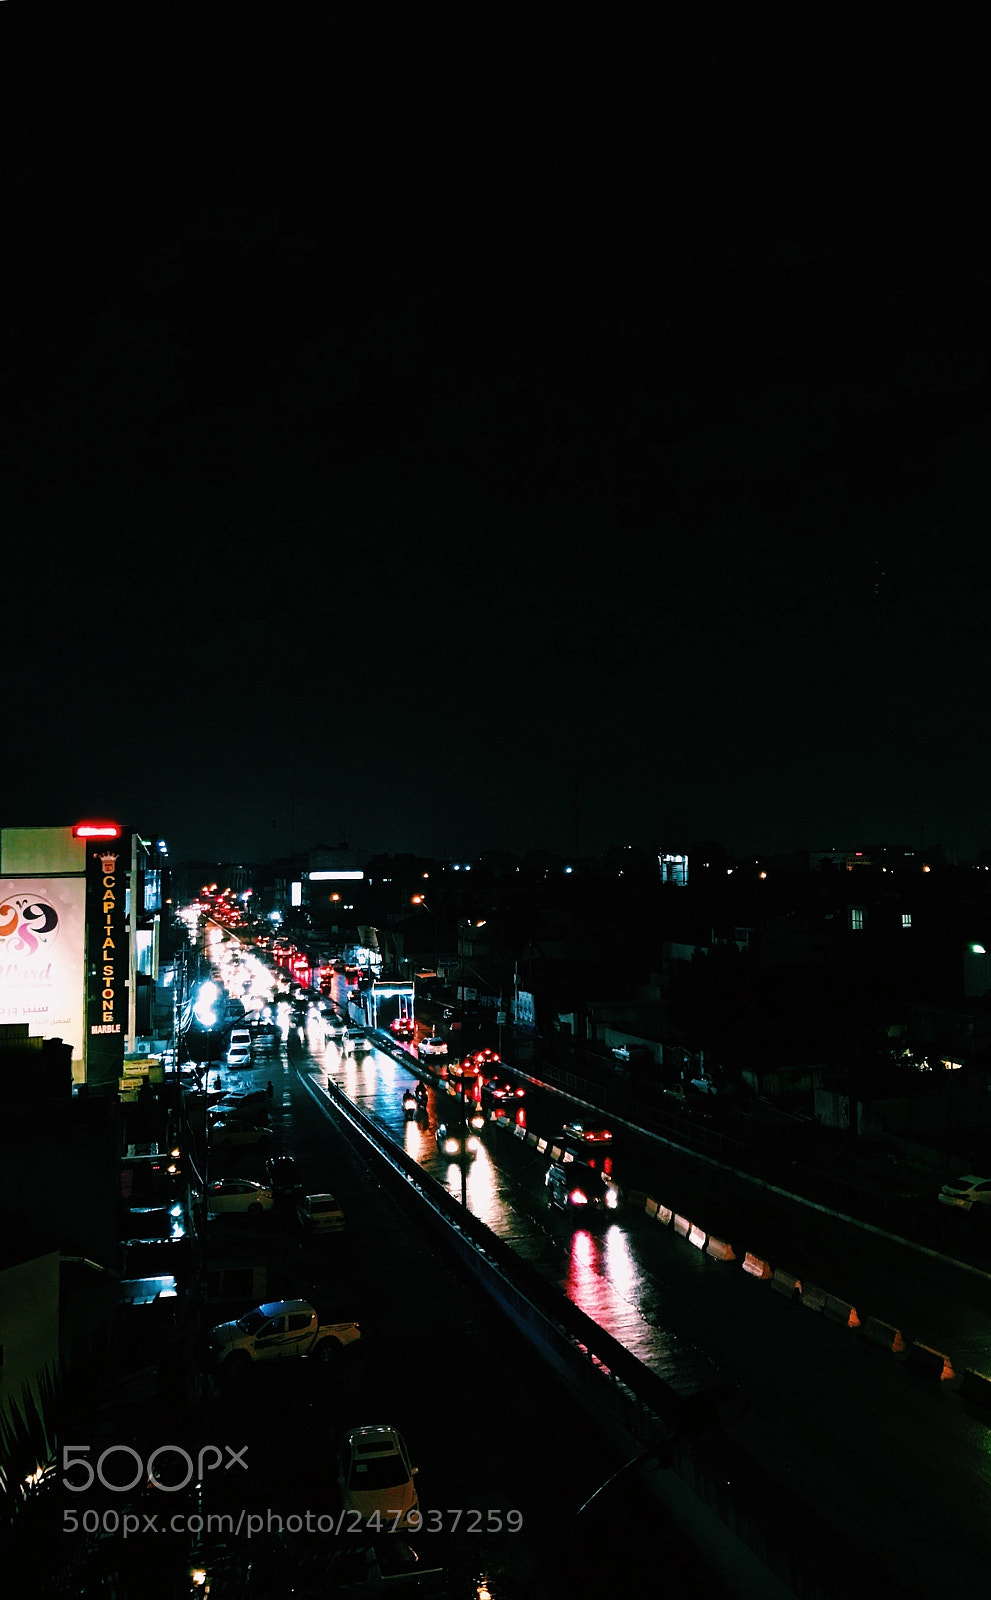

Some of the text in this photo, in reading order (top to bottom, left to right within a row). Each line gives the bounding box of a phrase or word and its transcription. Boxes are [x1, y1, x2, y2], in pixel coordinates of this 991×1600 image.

[102, 875, 116, 1023] CAPITAL STONE
[91, 1024, 121, 1035] MARBLE
